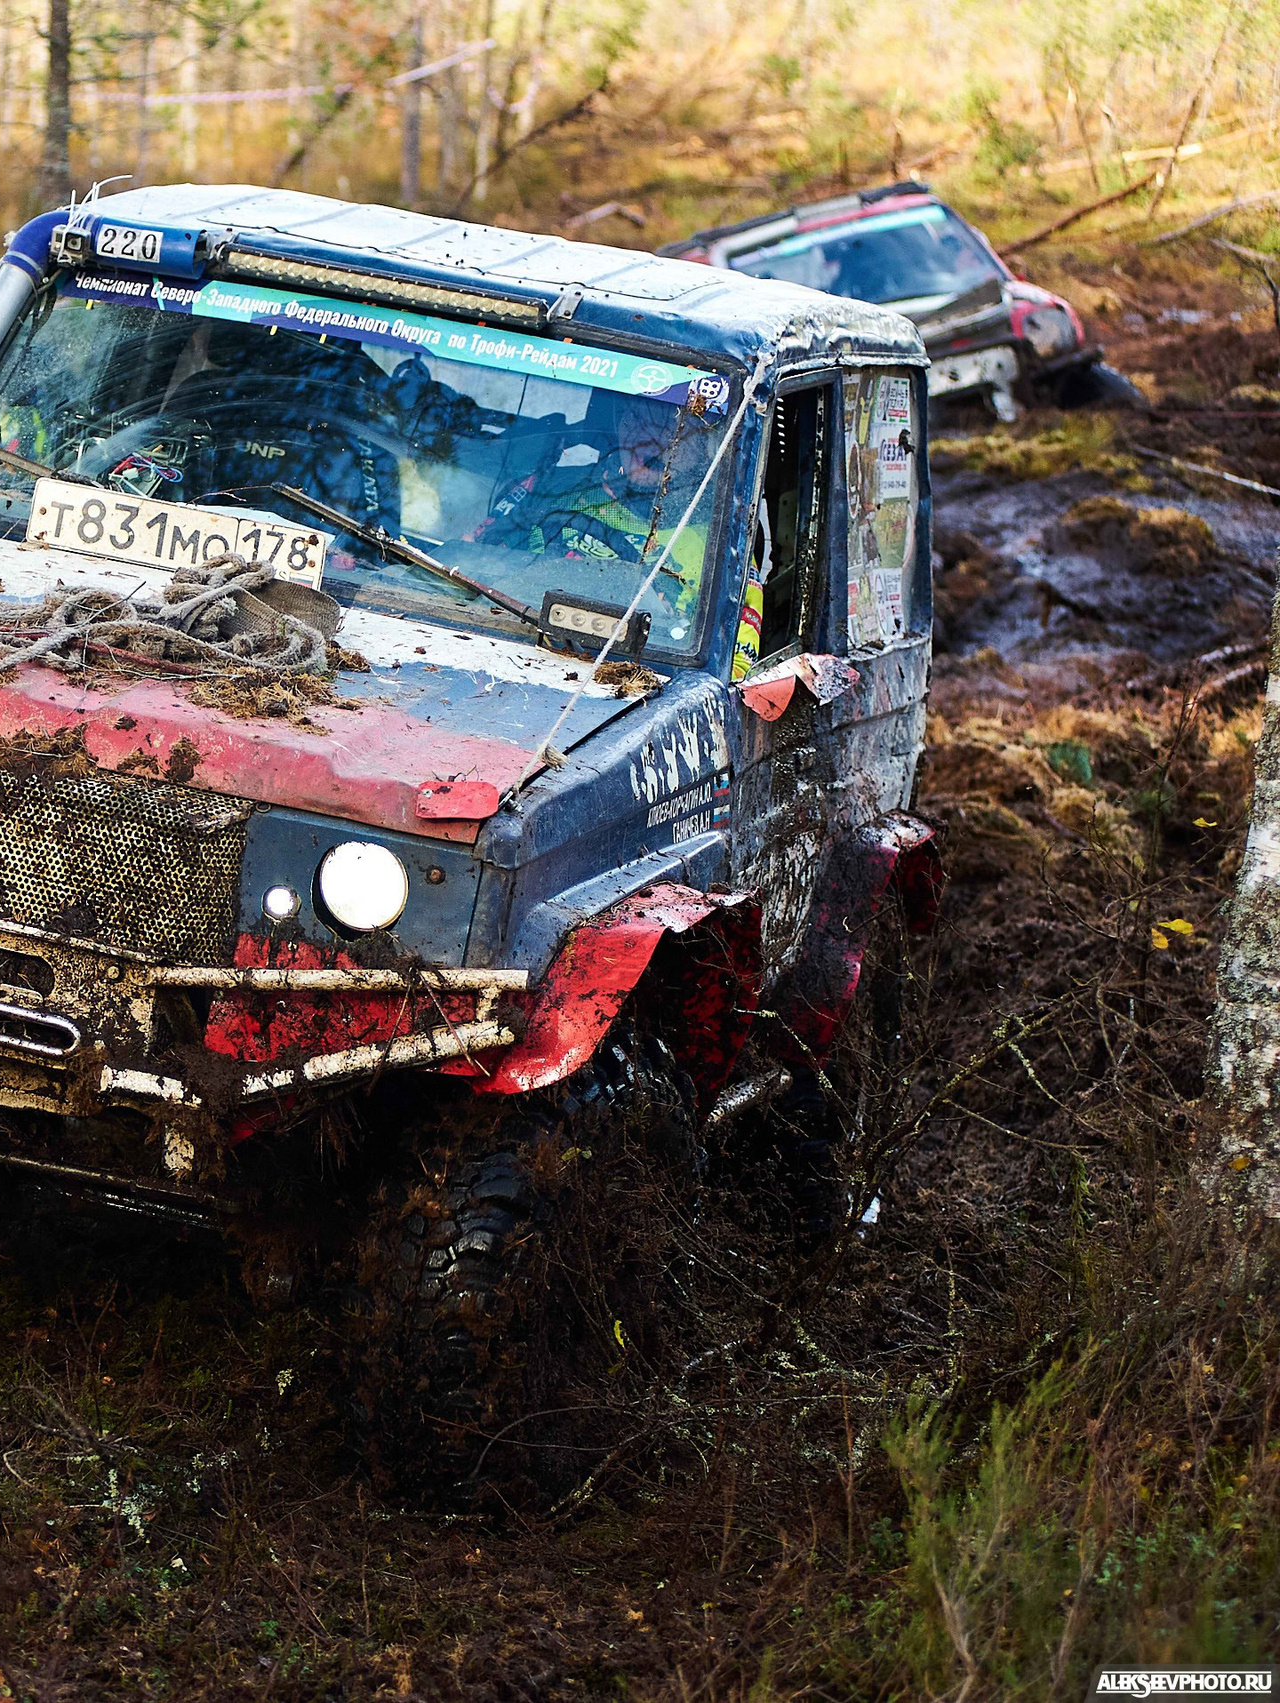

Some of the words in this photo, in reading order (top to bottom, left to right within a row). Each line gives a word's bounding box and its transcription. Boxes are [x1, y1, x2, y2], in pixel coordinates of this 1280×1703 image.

[100, 228, 158, 260] 220
[75, 271, 150, 298] Чемпионат
[151, 281, 281, 316] Северо-Западного
[284, 300, 387, 334] Федерального
[390, 318, 440, 345] Округа
[447, 334, 466, 350] по
[470, 333, 577, 370] Трофи-Рейдам
[579, 354, 619, 379] 2021
[242, 528, 309, 571] 178
